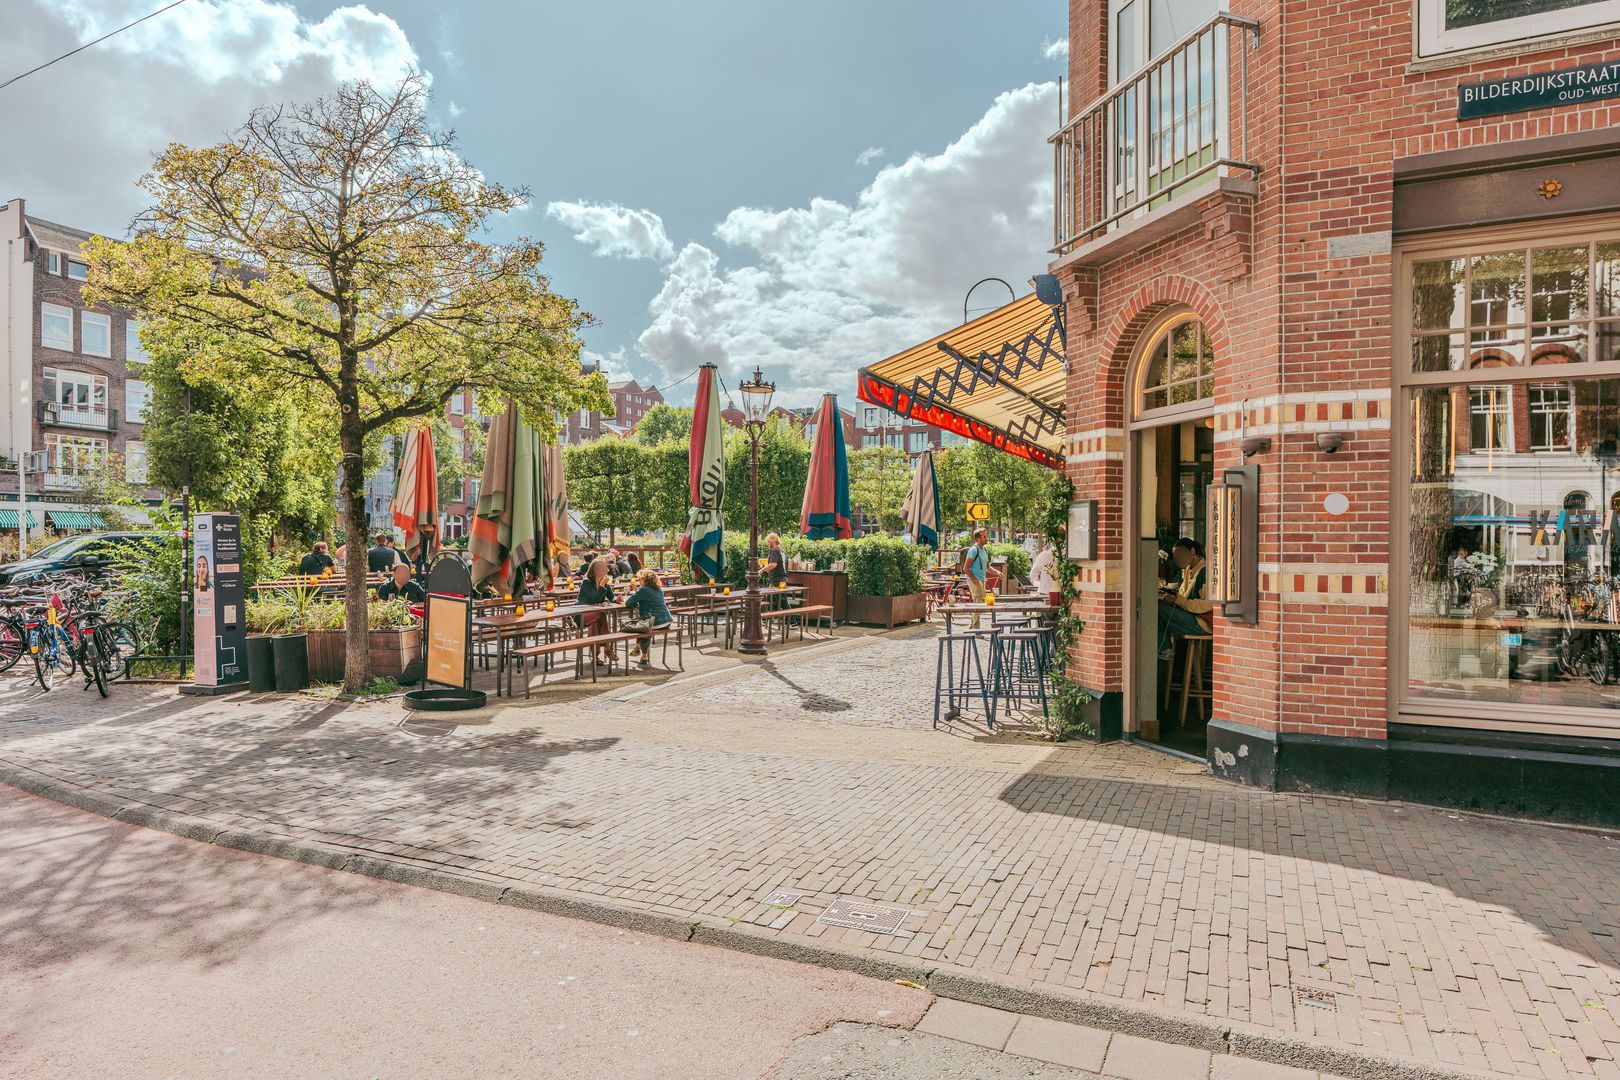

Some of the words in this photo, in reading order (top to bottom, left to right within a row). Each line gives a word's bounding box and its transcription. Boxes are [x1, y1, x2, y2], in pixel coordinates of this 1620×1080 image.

[1464, 65, 1620, 102] BILDERDIJKSTRAAT
[1559, 83, 1619, 101] OUD-WEST
[694, 457, 722, 527] BROU
